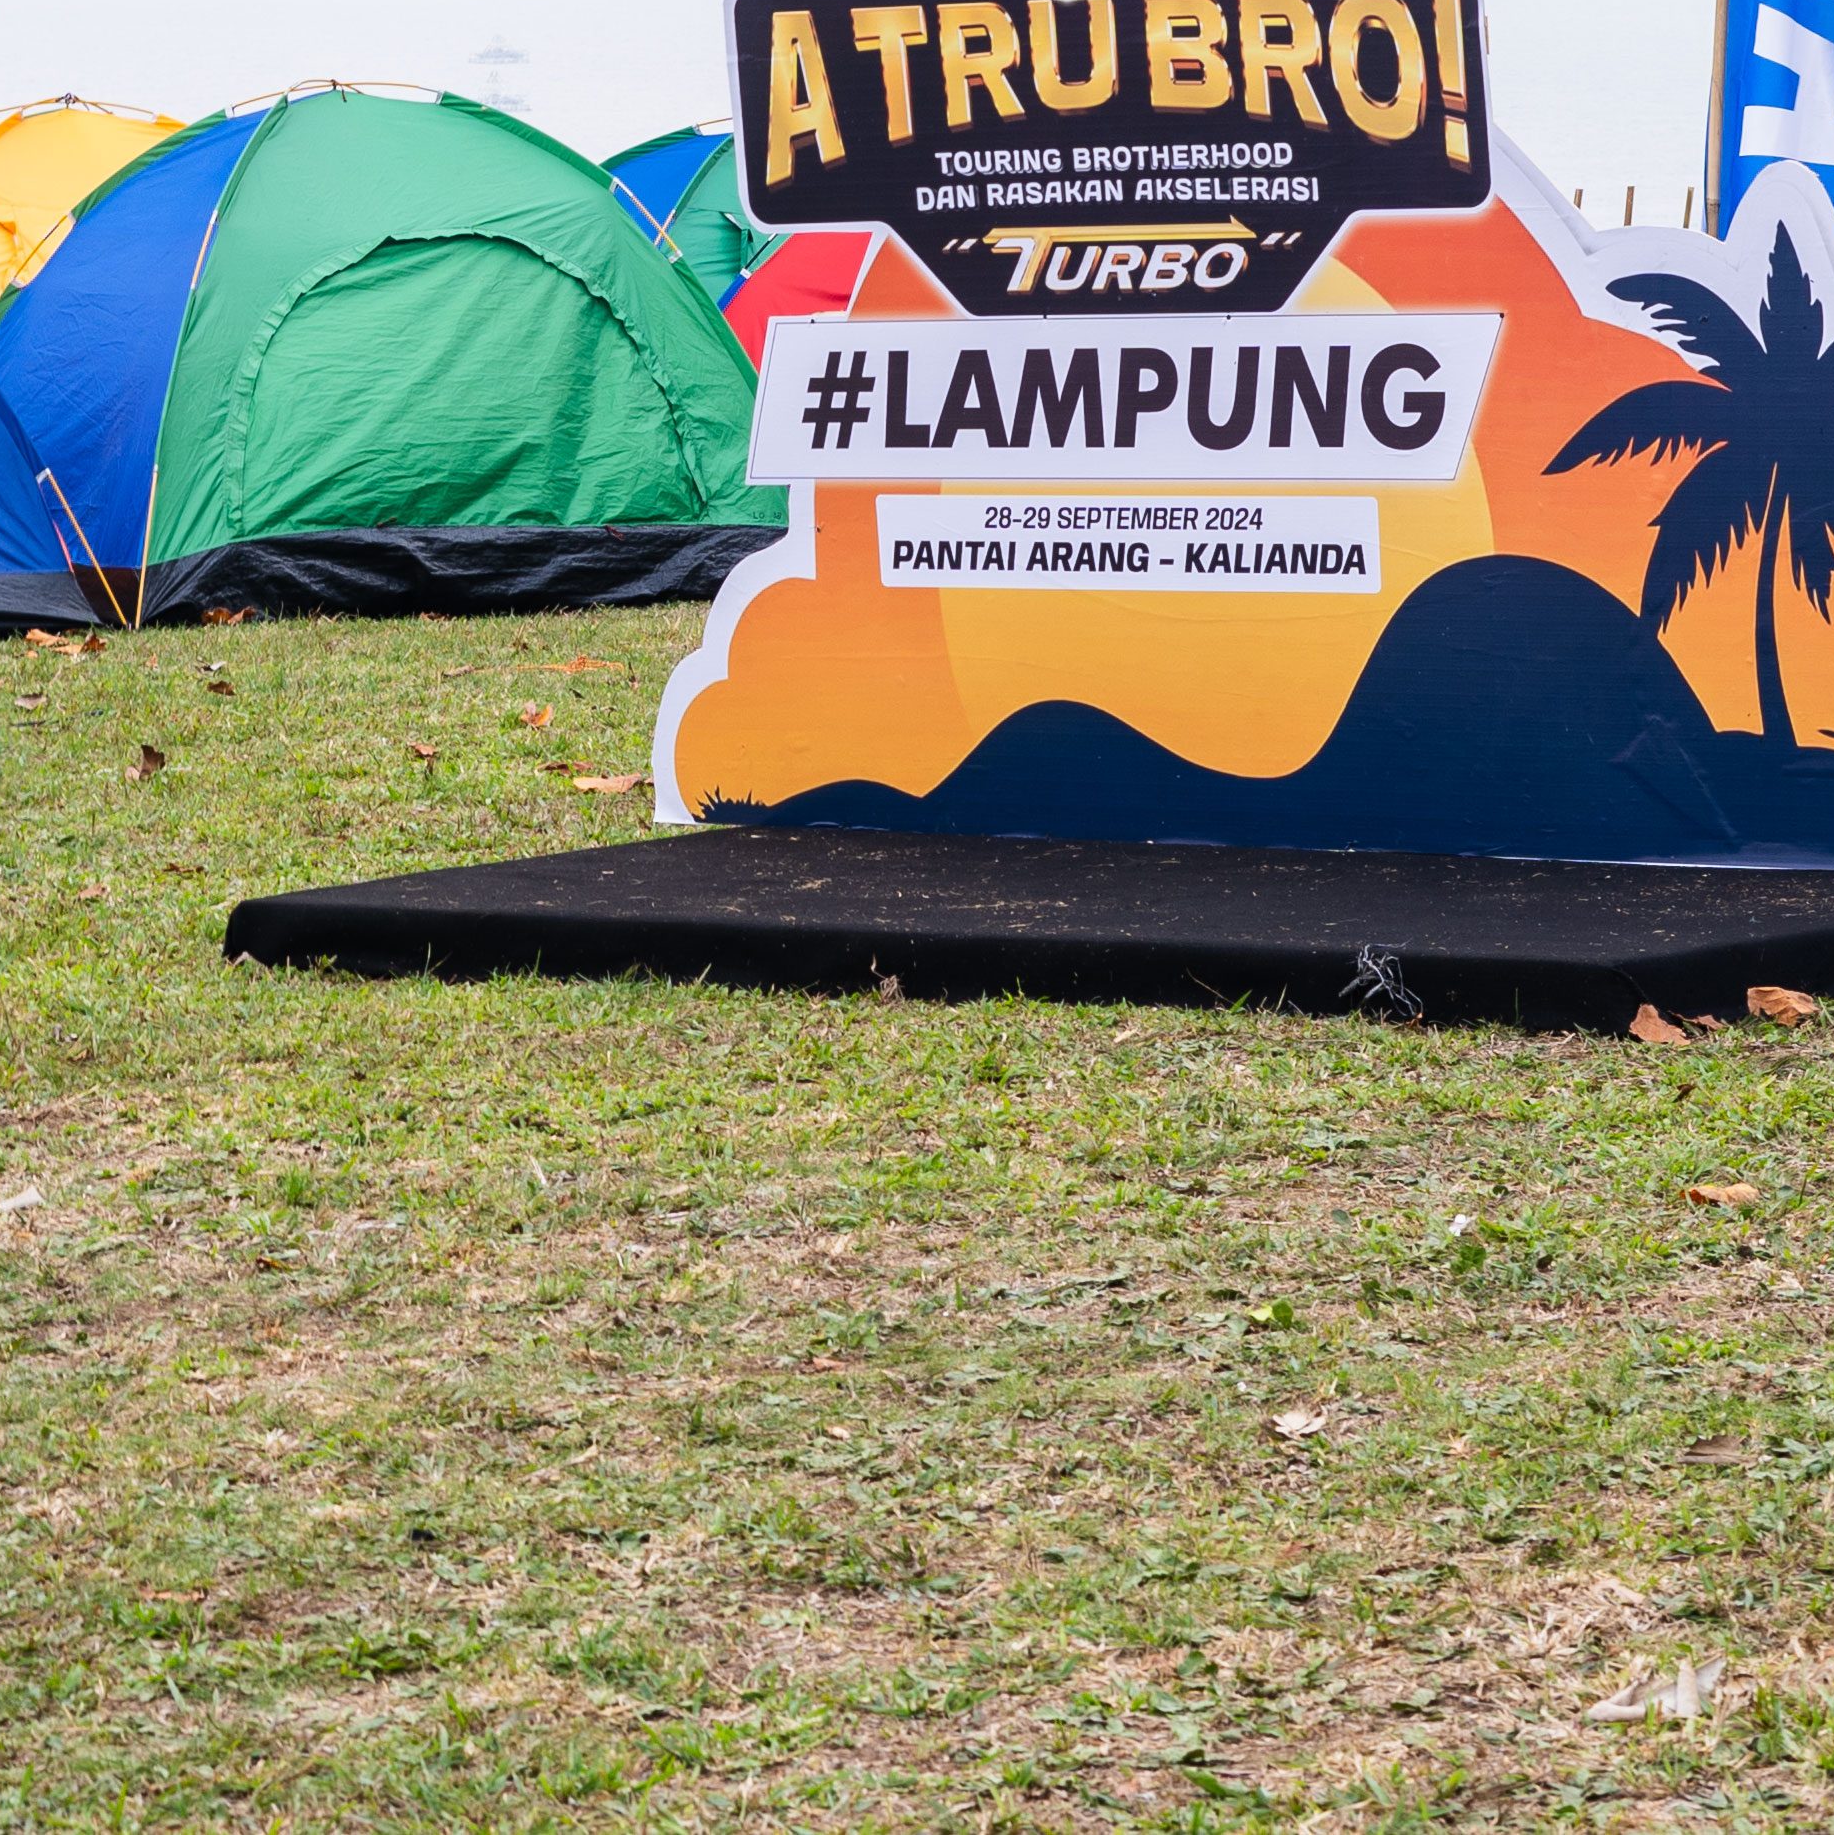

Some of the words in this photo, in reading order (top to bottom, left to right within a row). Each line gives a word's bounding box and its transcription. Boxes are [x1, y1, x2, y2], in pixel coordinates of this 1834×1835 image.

[765, 9, 847, 190] A
[934, 148, 1062, 176] TOURING
[1072, 142, 1293, 171] BROTHERHOOD
[916, 184, 977, 212] DAN
[987, 178, 1124, 206] RASAKAN
[1134, 176, 1320, 203] AKSELERASI
[801, 342, 1446, 450] #LAMPUNG
[984, 506, 1051, 529] 28-29
[1057, 506, 1199, 530] SEPTEMBER
[1205, 507, 1263, 531] 2024
[892, 540, 1016, 570] PANTAI
[1025, 542, 1149, 573] ARANG
[1159, 558, 1175, 566] -
[1184, 542, 1367, 575] KALIANDA
